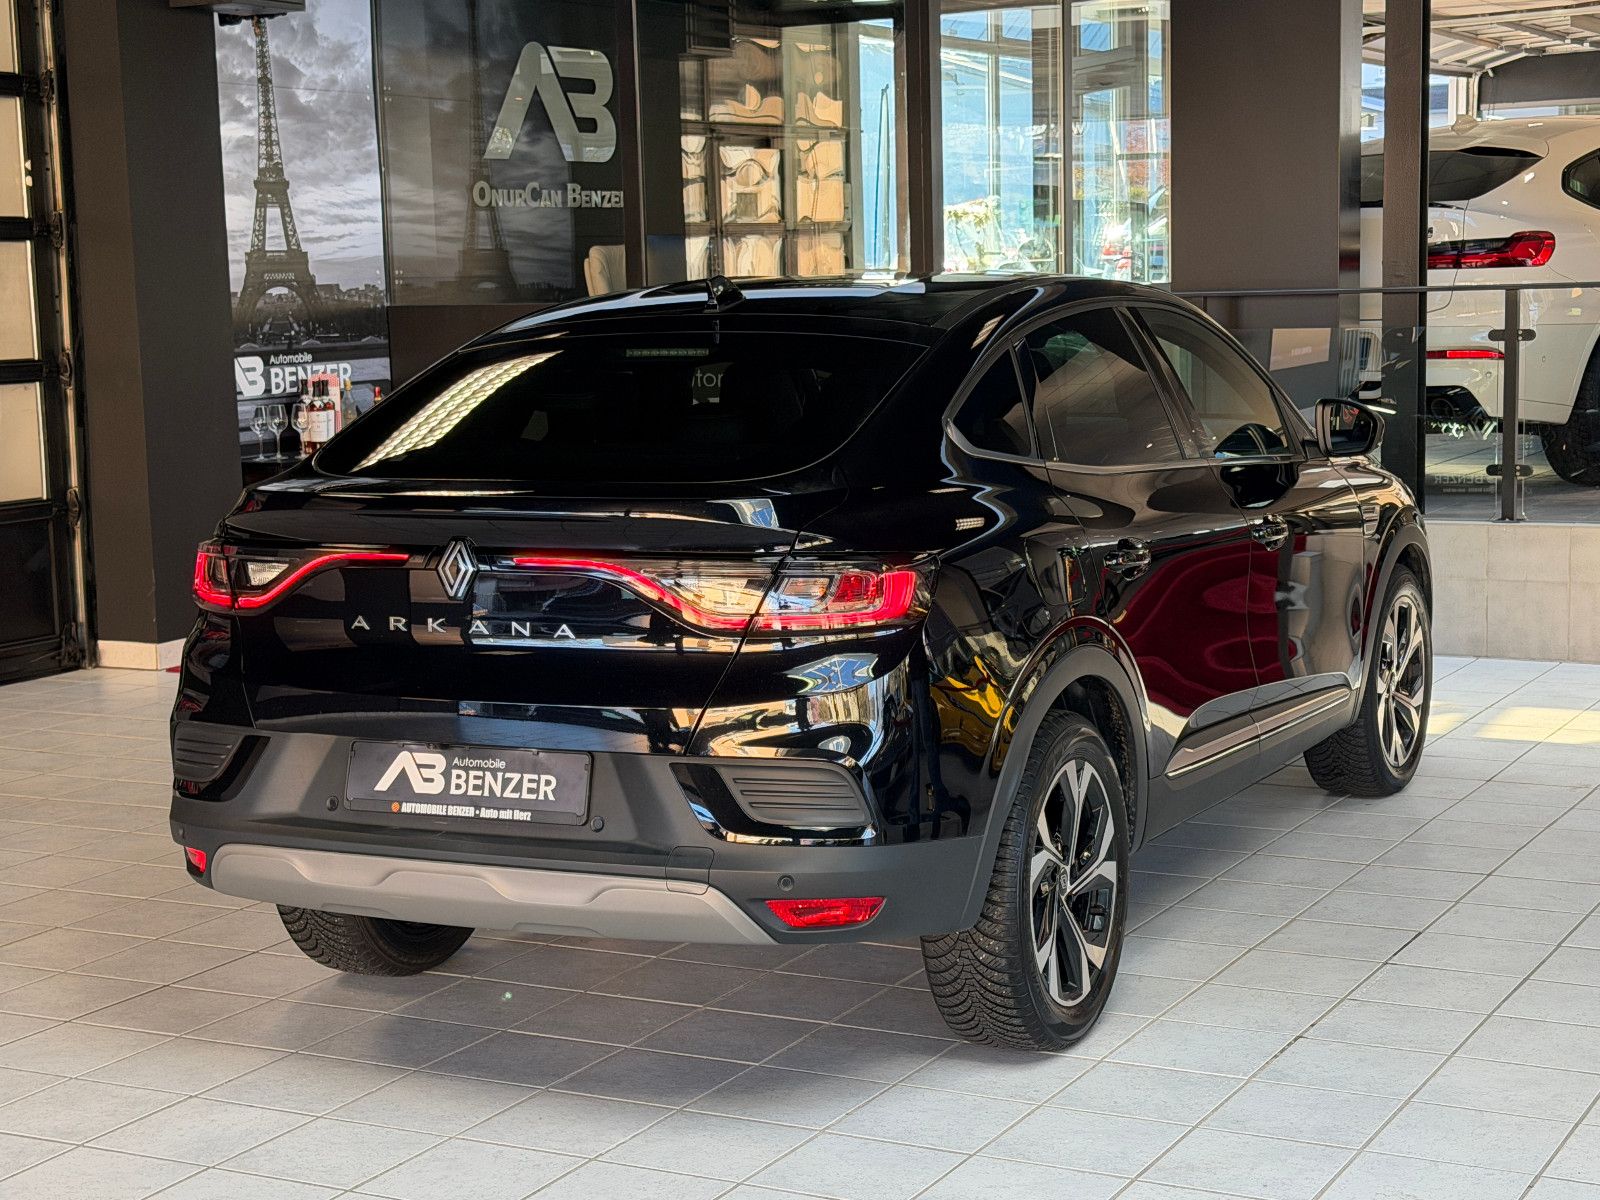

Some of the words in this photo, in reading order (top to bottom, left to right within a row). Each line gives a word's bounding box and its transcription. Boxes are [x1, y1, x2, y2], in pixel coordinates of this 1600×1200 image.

[483, 41, 617, 163] AB
[269, 351, 313, 365] Automobile
[350, 615, 577, 640] ARKANA
[373, 750, 447, 795] AB
[452, 756, 507, 770] Automobile
[449, 768, 558, 802] BENZER
[401, 801, 447, 816] AUTOMOBILE
[447, 804, 475, 817] BENZER
[479, 806, 498, 819] Auto
[499, 808, 513, 820] mit
[513, 808, 532, 821] Herz
